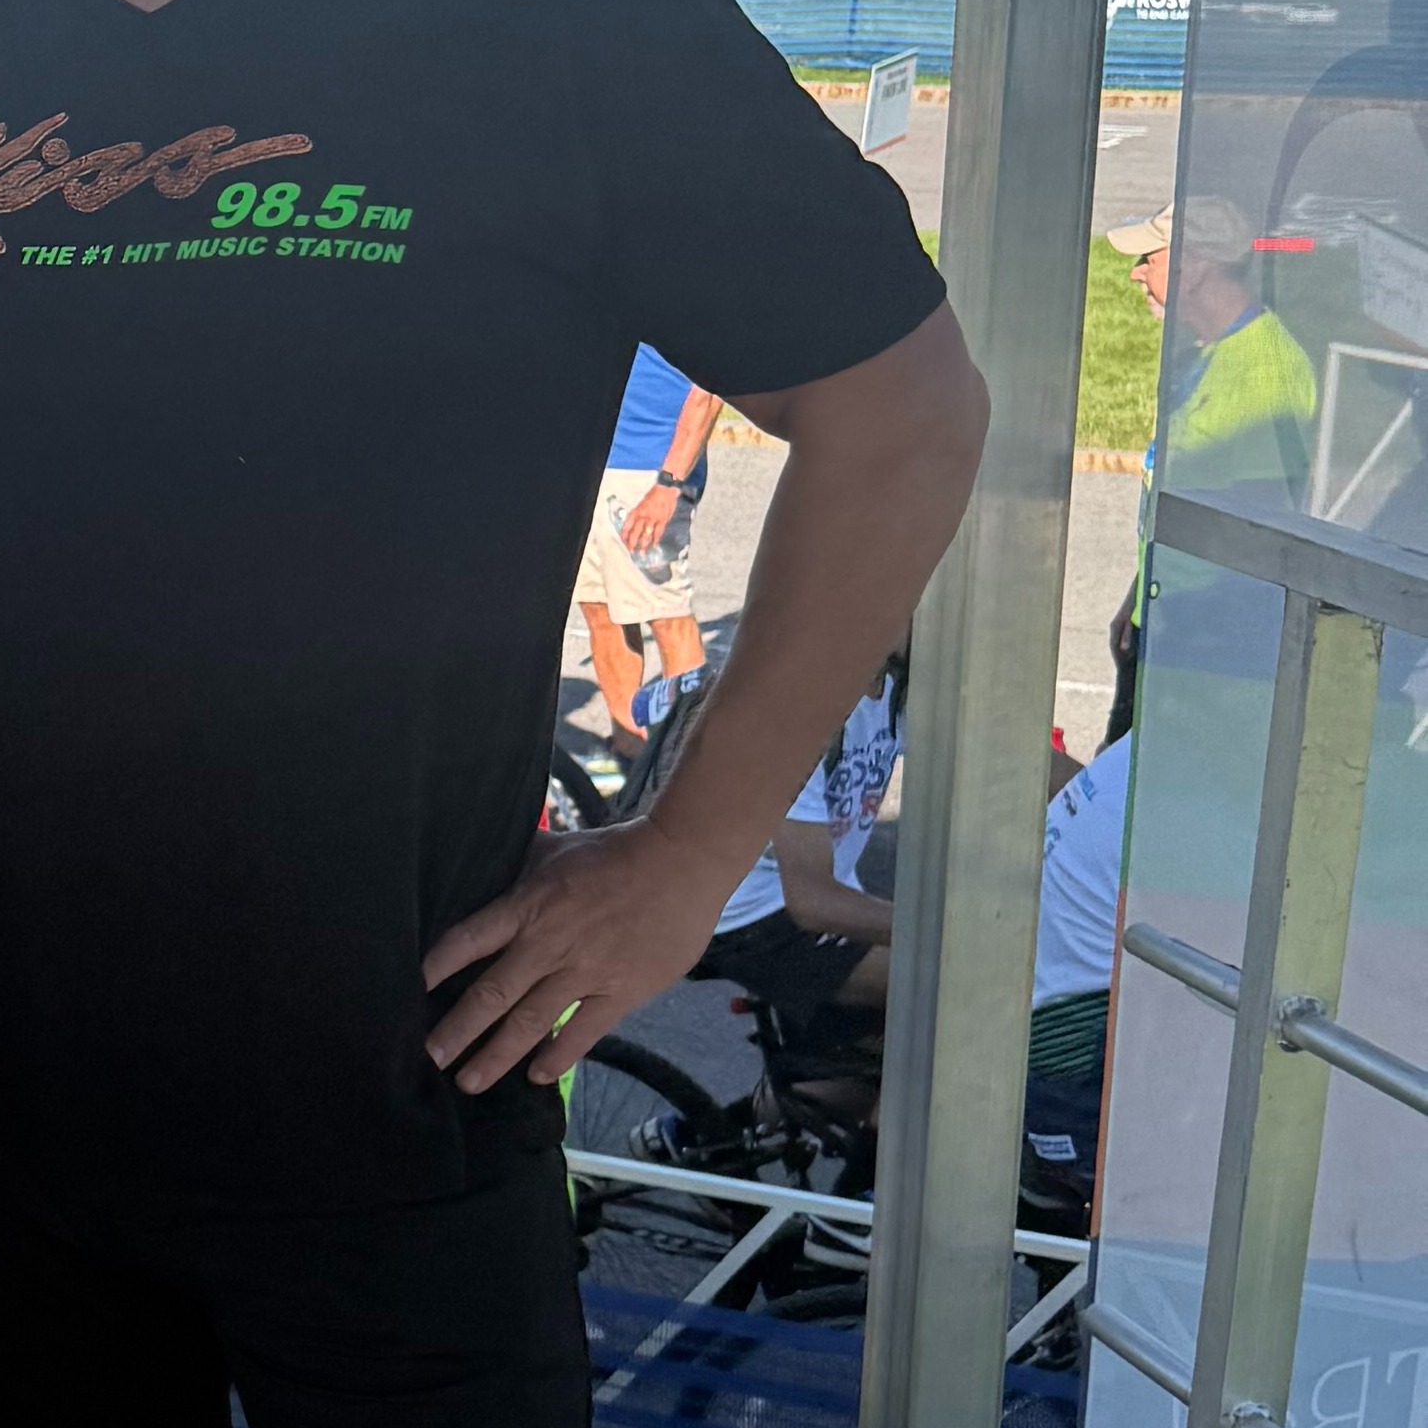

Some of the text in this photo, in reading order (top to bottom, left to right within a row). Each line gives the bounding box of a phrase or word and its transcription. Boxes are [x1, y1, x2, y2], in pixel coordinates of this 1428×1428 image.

[210, 181, 413, 232] 98.5 FM
[20, 236, 406, 266] THE #1 HIT MUSIC STATION
